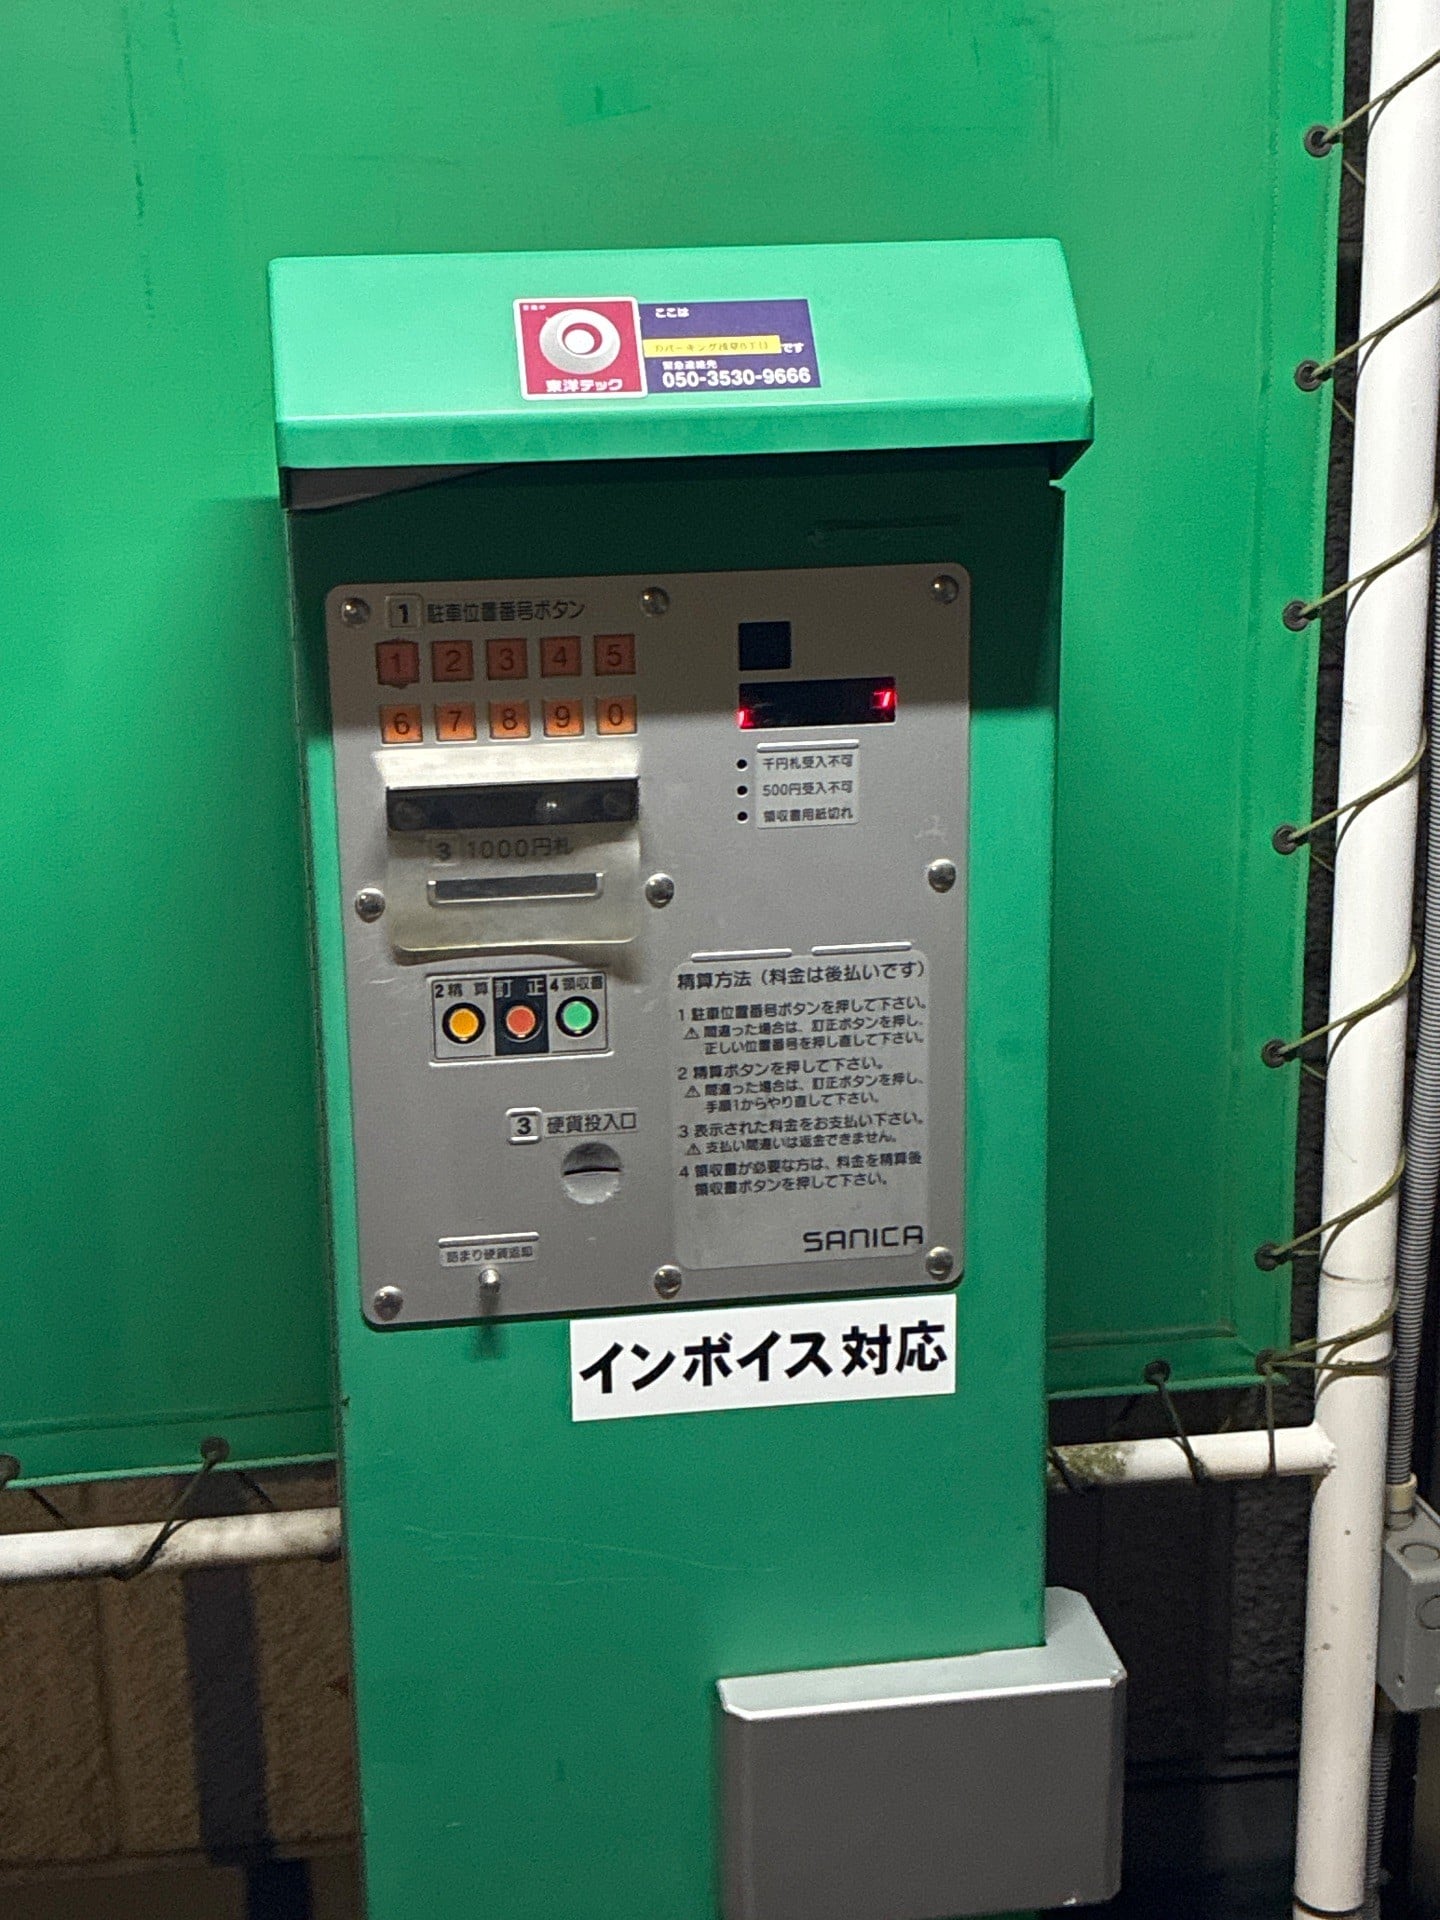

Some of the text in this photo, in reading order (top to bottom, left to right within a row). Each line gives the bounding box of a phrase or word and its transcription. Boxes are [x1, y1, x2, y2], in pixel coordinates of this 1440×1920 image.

[655, 307, 690, 319] ここは
[782, 341, 804, 355] です
[545, 378, 623, 393] 東洋テック
[662, 367, 811, 388] 050-3530-9666
[398, 601, 586, 624] 1 駐車位置番号ボタン
[392, 653, 402, 674] 1
[445, 650, 462, 672] 2
[500, 648, 515, 671] 3
[552, 646, 568, 667] 4
[607, 644, 622, 667] 5
[394, 712, 410, 735] 6
[449, 710, 462, 733] 7
[502, 708, 518, 730] 8
[554, 705, 570, 728] 9
[608, 703, 624, 726] 0
[763, 754, 853, 770] 千円札受入不可
[762, 780, 853, 796] 500円受入不可
[763, 807, 853, 822] 領収書用紙切れ
[468, 838, 573, 859] 1000円札
[495, 978, 545, 998] 訂正
[562, 975, 603, 991] 領収書
[691, 997, 927, 1022] 駐車位置番号ボタンを押して下さい。
[693, 1056, 883, 1079] 精算ボタンを押して下さい。
[517, 1112, 637, 1135] 3 硬貨投入口
[694, 1111, 924, 1137] 表示された料金をお支払い下さい。
[705, 1130, 897, 1154] 支払い間違いは返金できません。
[694, 1172, 888, 1197] 領収書ボタンを押して下さい。
[803, 1224, 924, 1252] SANICA
[579, 1320, 948, 1394] インボイス対応
